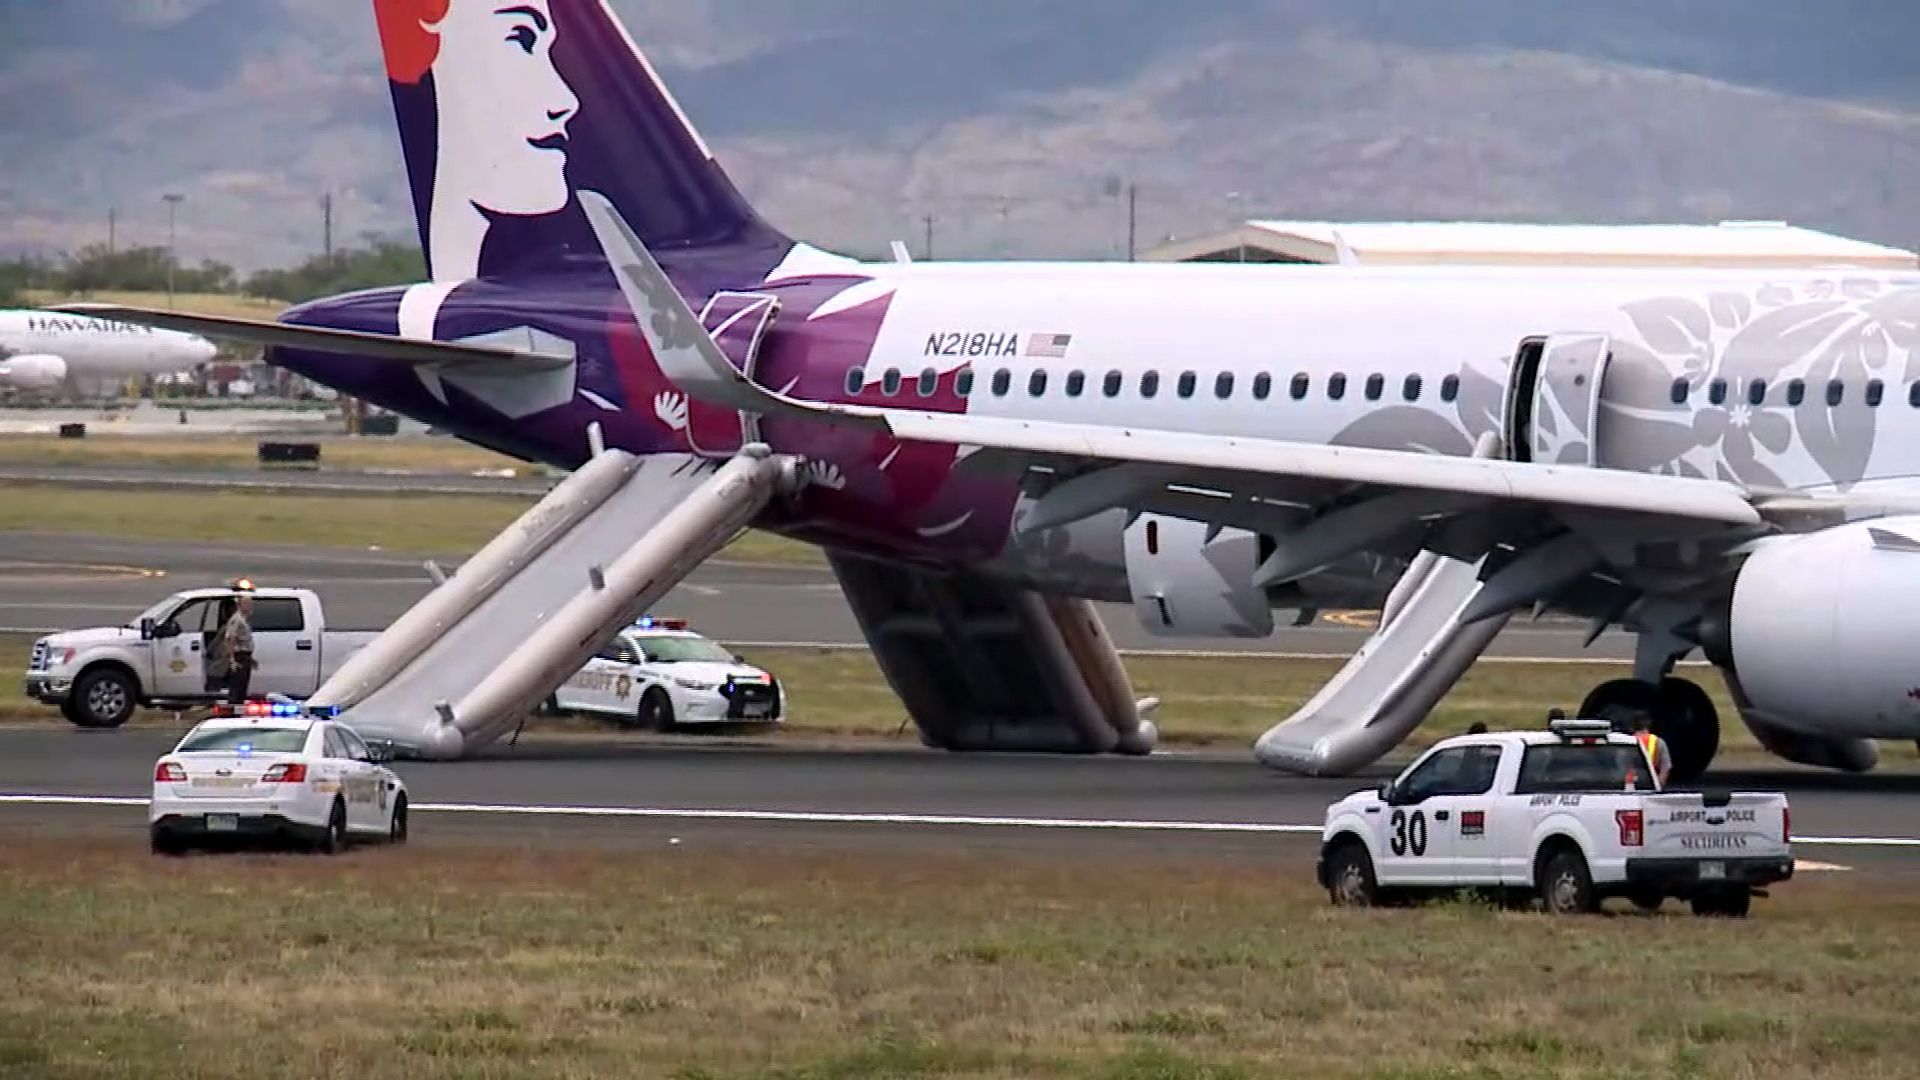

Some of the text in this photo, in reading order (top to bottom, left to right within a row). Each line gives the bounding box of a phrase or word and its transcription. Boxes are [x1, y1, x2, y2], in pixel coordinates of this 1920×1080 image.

[924, 332, 1018, 357] N218HA
[1670, 809, 1756, 823] AIRPORT POLICE
[1391, 809, 1428, 857] 30
[1680, 836, 1747, 849] SECURITAS
